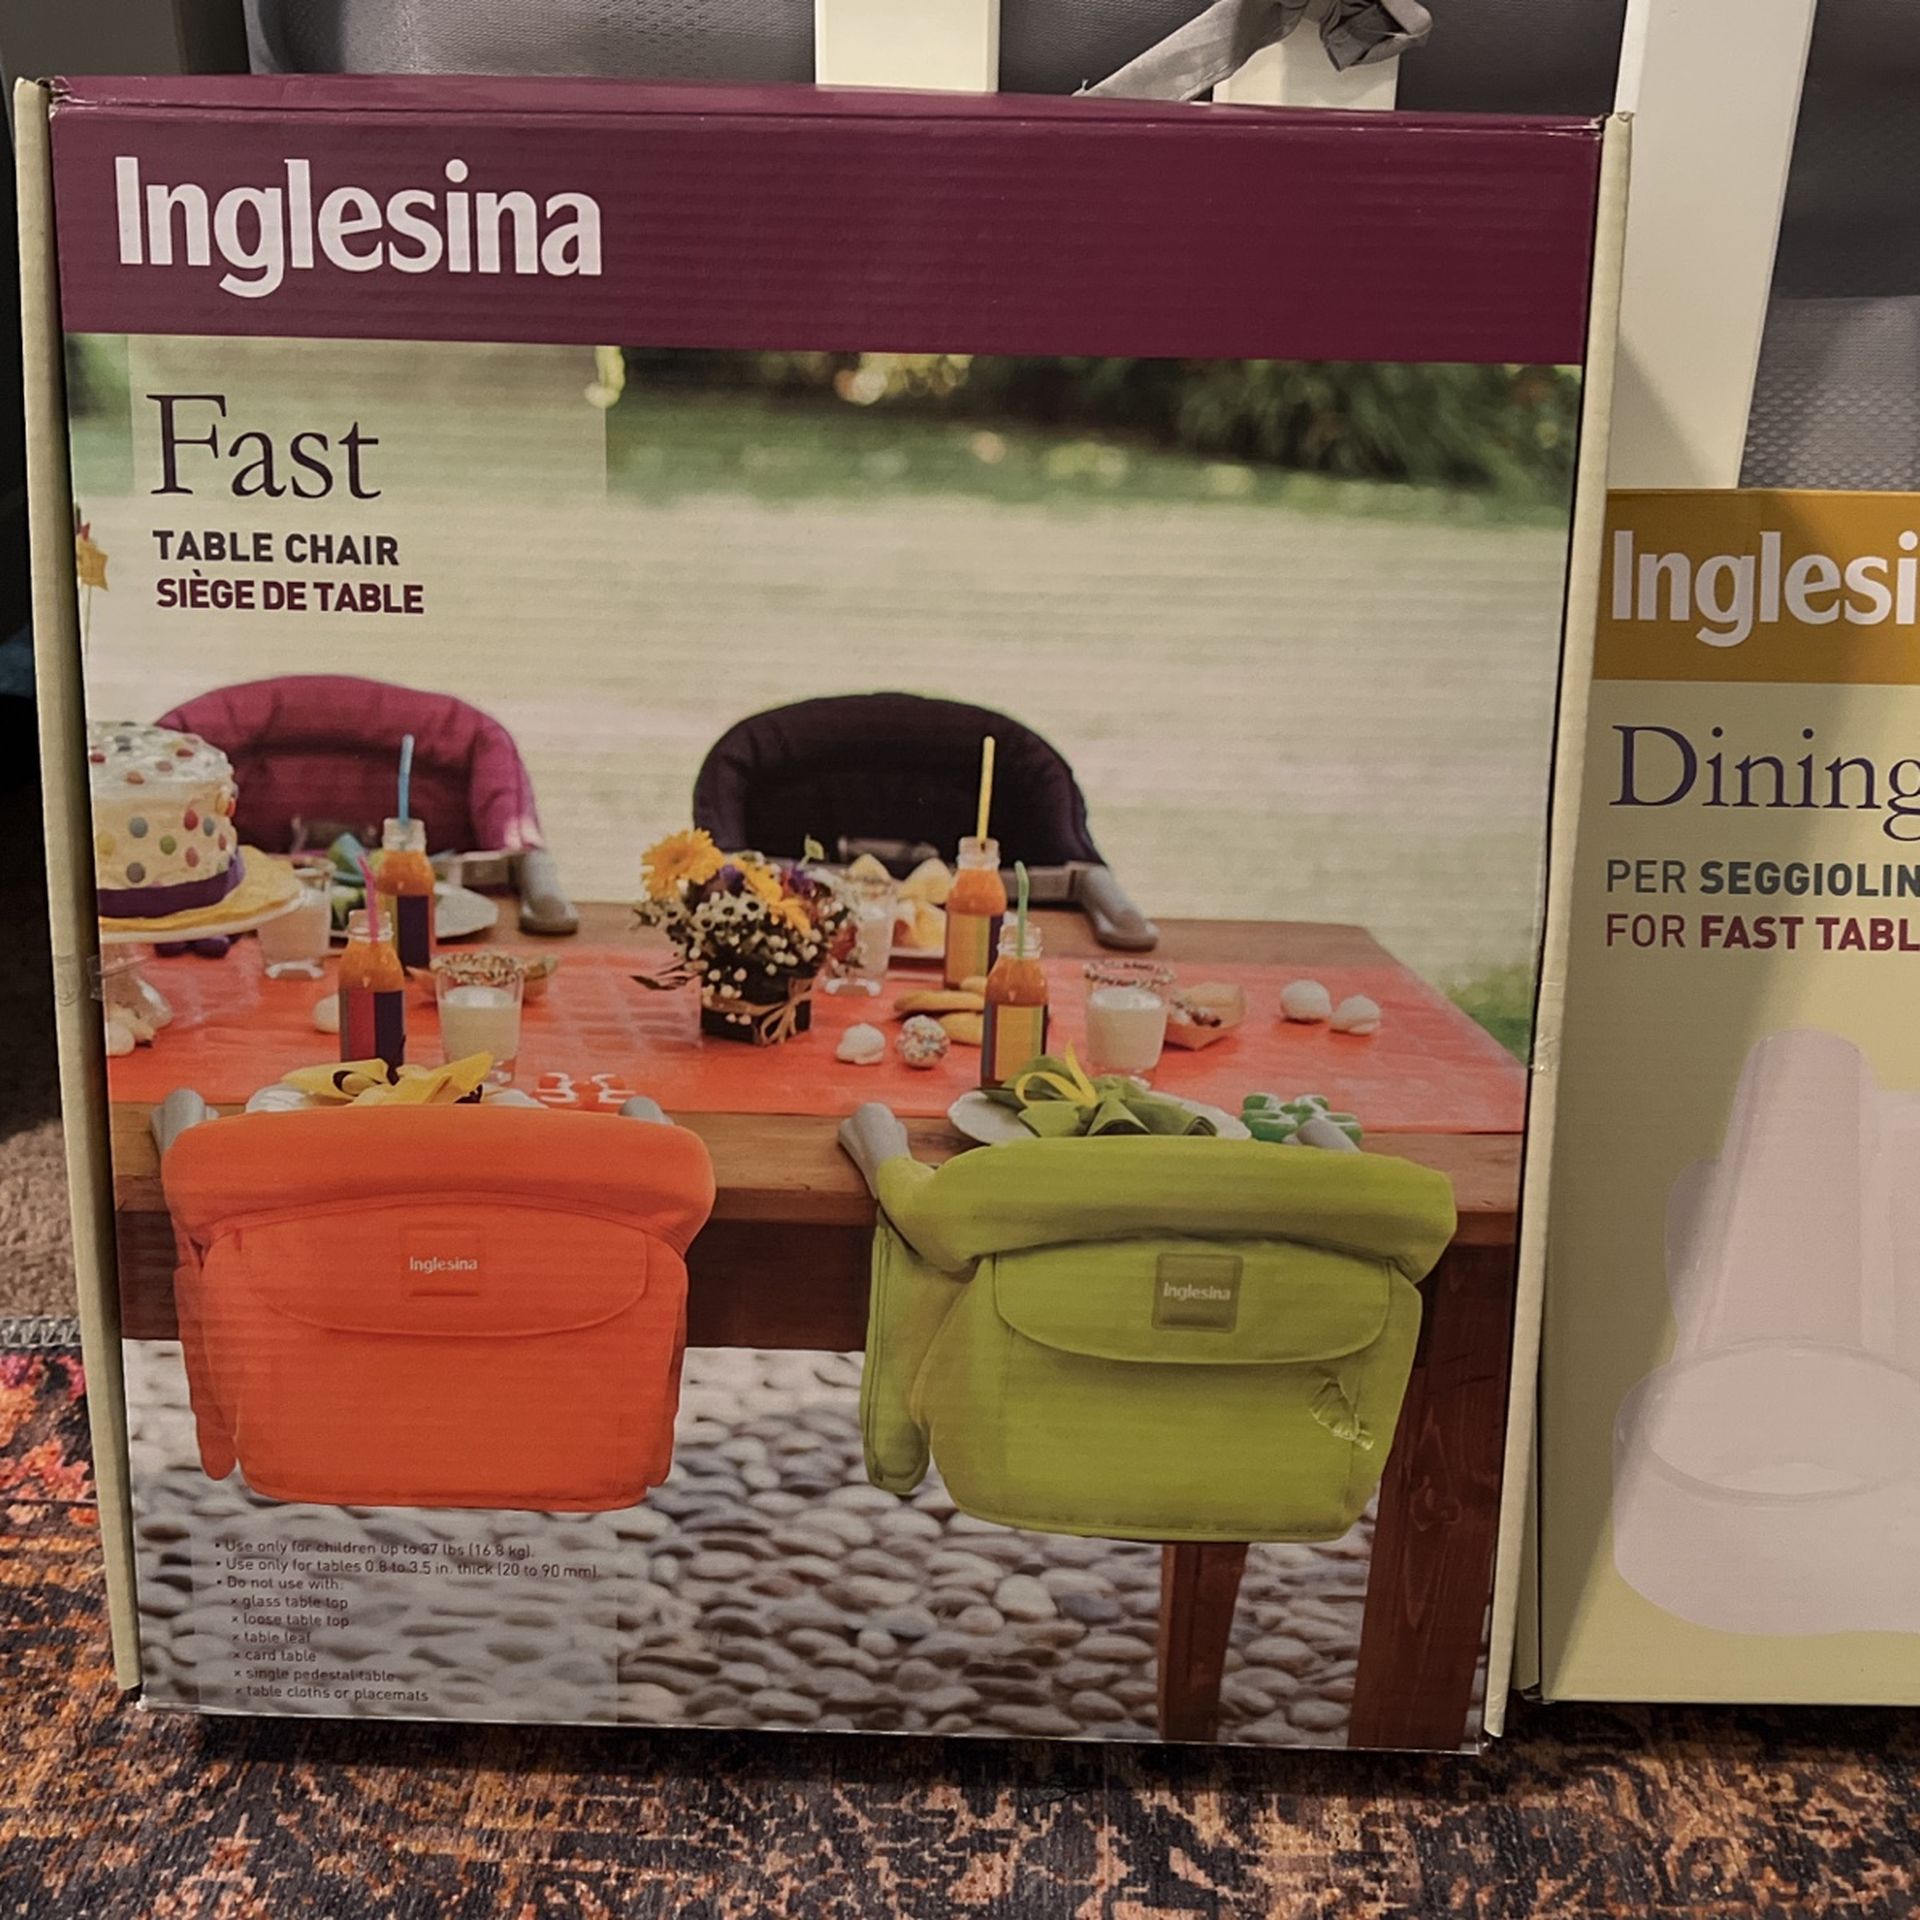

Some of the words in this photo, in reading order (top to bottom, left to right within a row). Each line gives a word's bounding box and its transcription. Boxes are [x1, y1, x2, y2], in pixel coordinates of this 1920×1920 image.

[115, 156, 602, 298] Inglesina
[146, 394, 381, 500] Fast
[152, 530, 273, 562] TABLE
[285, 533, 399, 566] CHAIR
[156, 568, 255, 609] SIÈGE
[263, 580, 307, 611] DE
[313, 582, 424, 614] TABLE
[1612, 530, 1918, 647] Inglesi
[1609, 725, 1920, 841] Dining
[1607, 860, 1685, 893] PER
[1700, 861, 1920, 897] SEGGIOLIN
[1606, 914, 1684, 947] FOR
[1701, 917, 1803, 950] FAST
[1816, 917, 1920, 951] TABL
[410, 1256, 478, 1273] Inglesina
[1163, 1282, 1231, 1301] Inglesina
[225, 1540, 253, 1552] Use
[258, 1541, 287, 1555] only
[292, 1541, 313, 1552] for
[316, 1542, 375, 1554] children
[381, 1545, 398, 1556] up
[403, 1544, 416, 1554] to
[443, 1544, 464, 1556] lbs
[226, 1558, 253, 1570] Use
[258, 1559, 288, 1574] only
[293, 1560, 311, 1571] for
[317, 1560, 361, 1572] tables
[391, 1562, 406, 1573] to
[458, 1563, 493, 1575] thick
[498, 1562, 520, 1577] (20
[524, 1565, 537, 1576] to
[542, 1563, 559, 1577] 90
[227, 1576, 246, 1588] Do
[251, 1578, 273, 1588] not
[278, 1580, 303, 1589] use
[242, 1595, 280, 1610] glass
[286, 1596, 321, 1608] table
[326, 1597, 348, 1610] top
[243, 1612, 282, 1625] loose
[287, 1614, 322, 1626] table
[326, 1615, 349, 1629] top
[244, 1631, 279, 1643] table
[284, 1631, 311, 1644] leaf
[245, 1649, 276, 1661] card
[281, 1649, 316, 1662] table
[246, 1667, 289, 1681] single
[294, 1668, 353, 1682] pedestal
[359, 1670, 394, 1682] table
[247, 1685, 282, 1697] table
[287, 1685, 330, 1699] cloths
[334, 1688, 350, 1699] or
[354, 1687, 429, 1702] placemats
